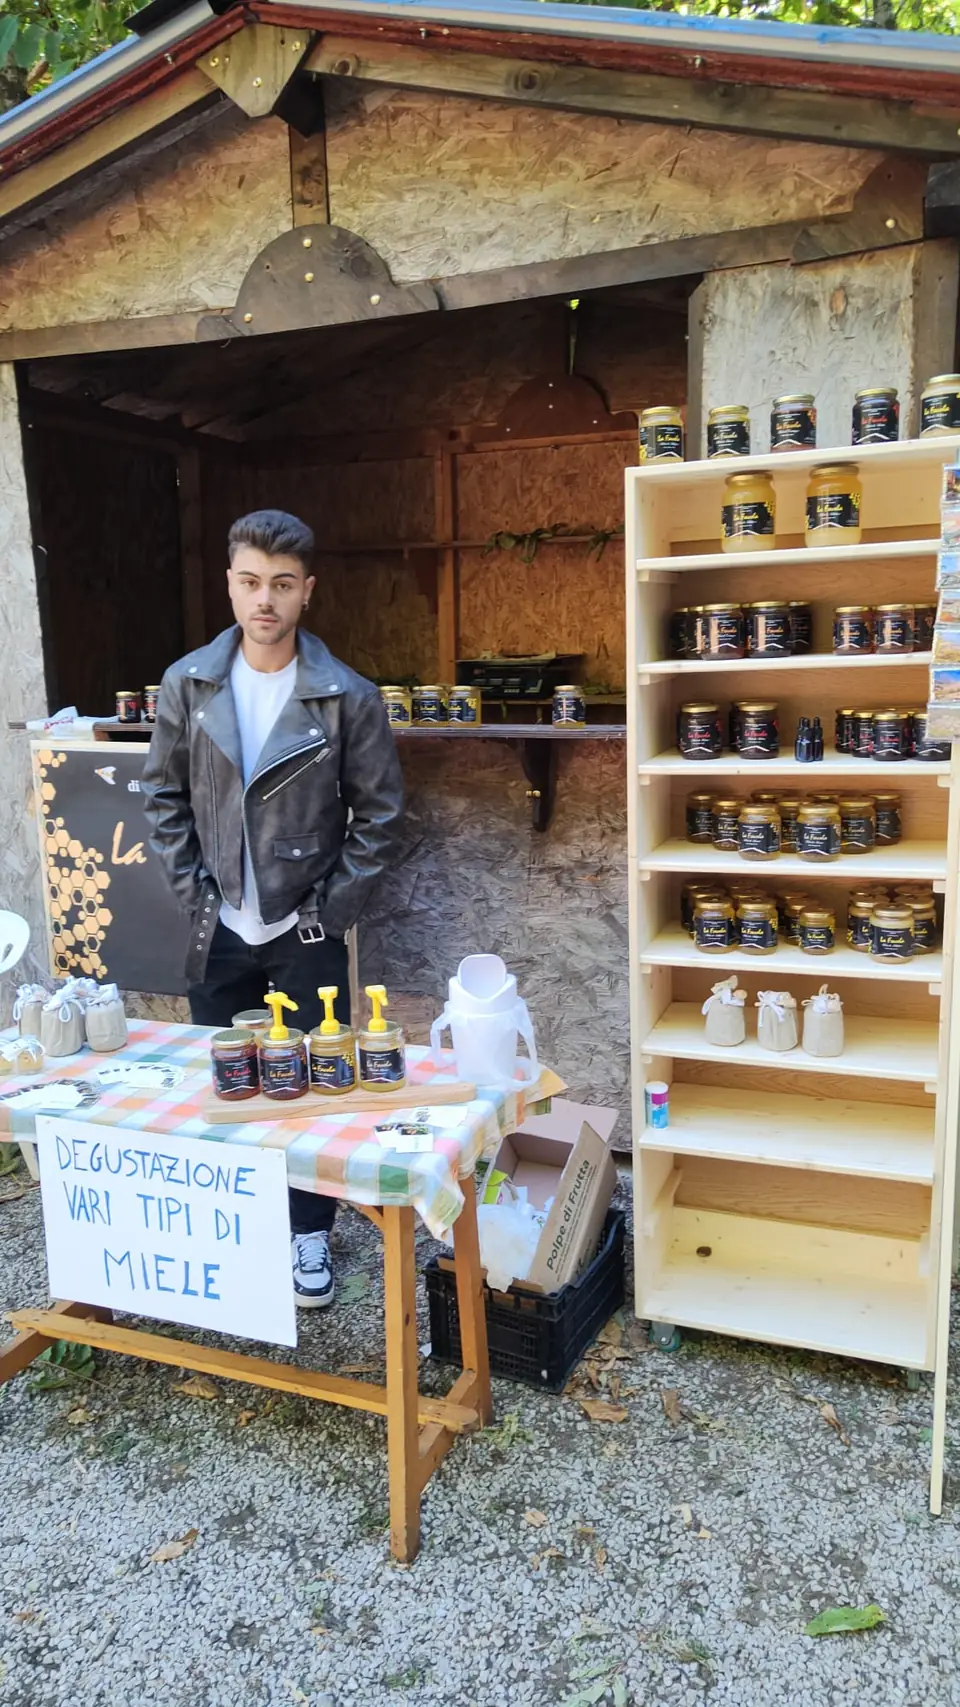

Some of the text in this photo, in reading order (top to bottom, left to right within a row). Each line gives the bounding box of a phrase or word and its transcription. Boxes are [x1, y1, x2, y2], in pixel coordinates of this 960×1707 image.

[127, 780, 141, 792] di
[111, 821, 148, 865] La
[55, 1135, 256, 1197] DEGUSTAZIONE
[568, 1159, 590, 1205] Frutta
[63, 1181, 241, 1245] VARI TIPI DI
[564, 1207, 573, 1223] di
[547, 1226, 567, 1270] Polpe
[103, 1248, 221, 1300] MIELE
